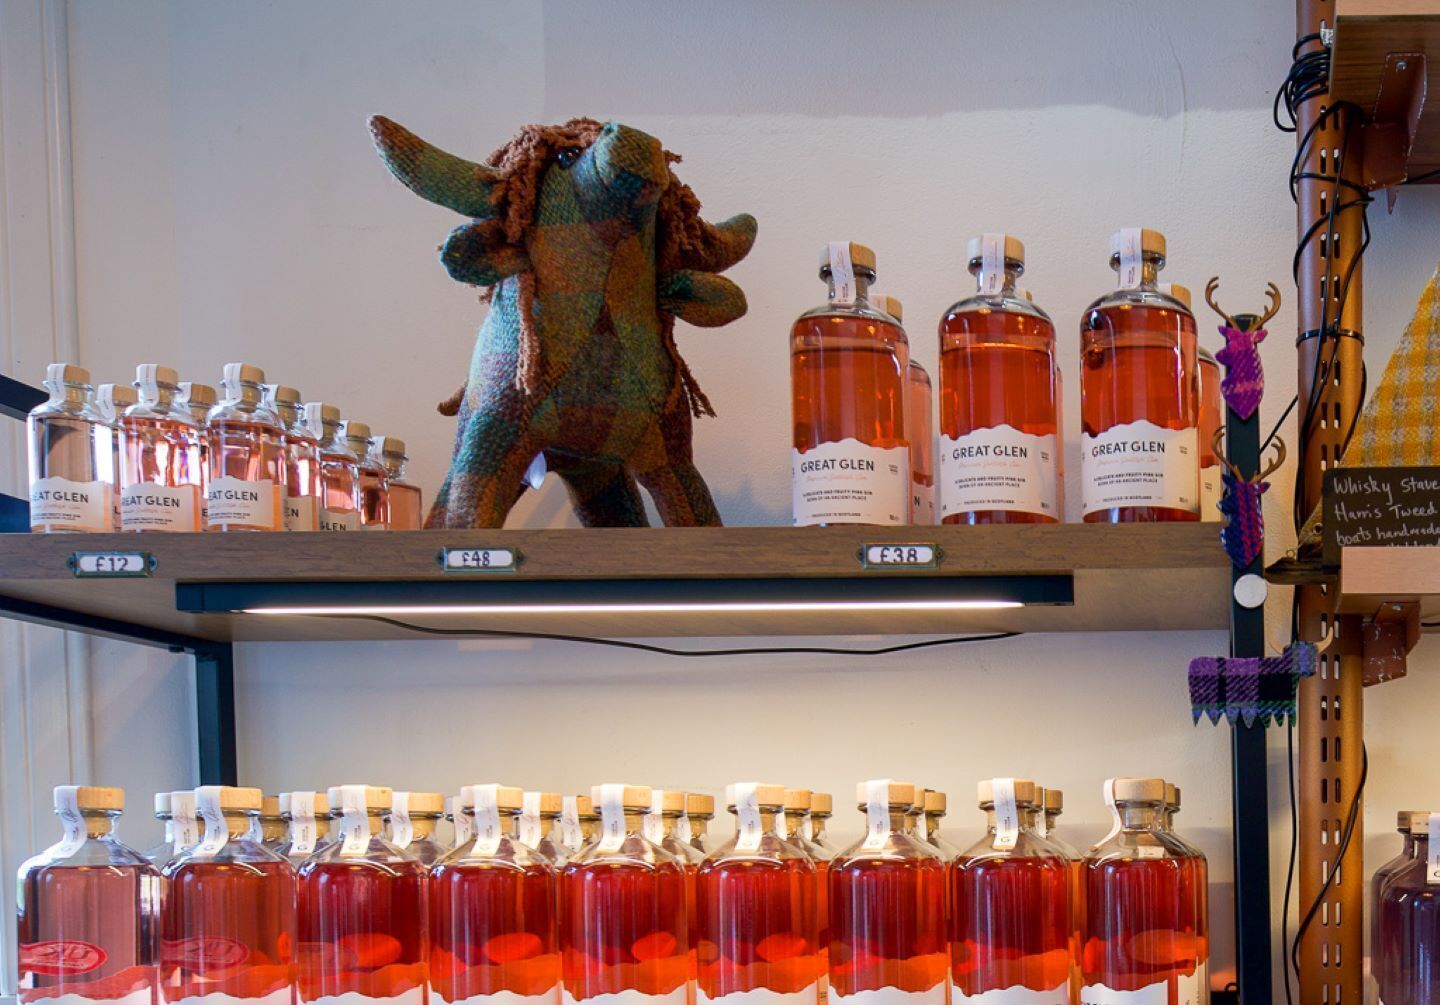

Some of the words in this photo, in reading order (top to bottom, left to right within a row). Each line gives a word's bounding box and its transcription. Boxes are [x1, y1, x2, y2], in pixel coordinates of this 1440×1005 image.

[952, 445, 990, 460] GREAT
[993, 445, 1028, 459] GLEN
[1091, 441, 1128, 457] GREAT
[1130, 441, 1165, 454] GLEN
[800, 459, 837, 473] GREAT
[839, 459, 875, 471] GLEN
[53, 491, 89, 504] GLEN
[224, 490, 259, 502] GLEN
[1333, 476, 1393, 505] Whisky
[144, 495, 181, 508] GLEN
[1391, 505, 1439, 519] Tweed
[1336, 526, 1372, 546] boats
[461, 551, 490, 567] £48
[880, 546, 918, 563] £38
[95, 556, 129, 572] £12
